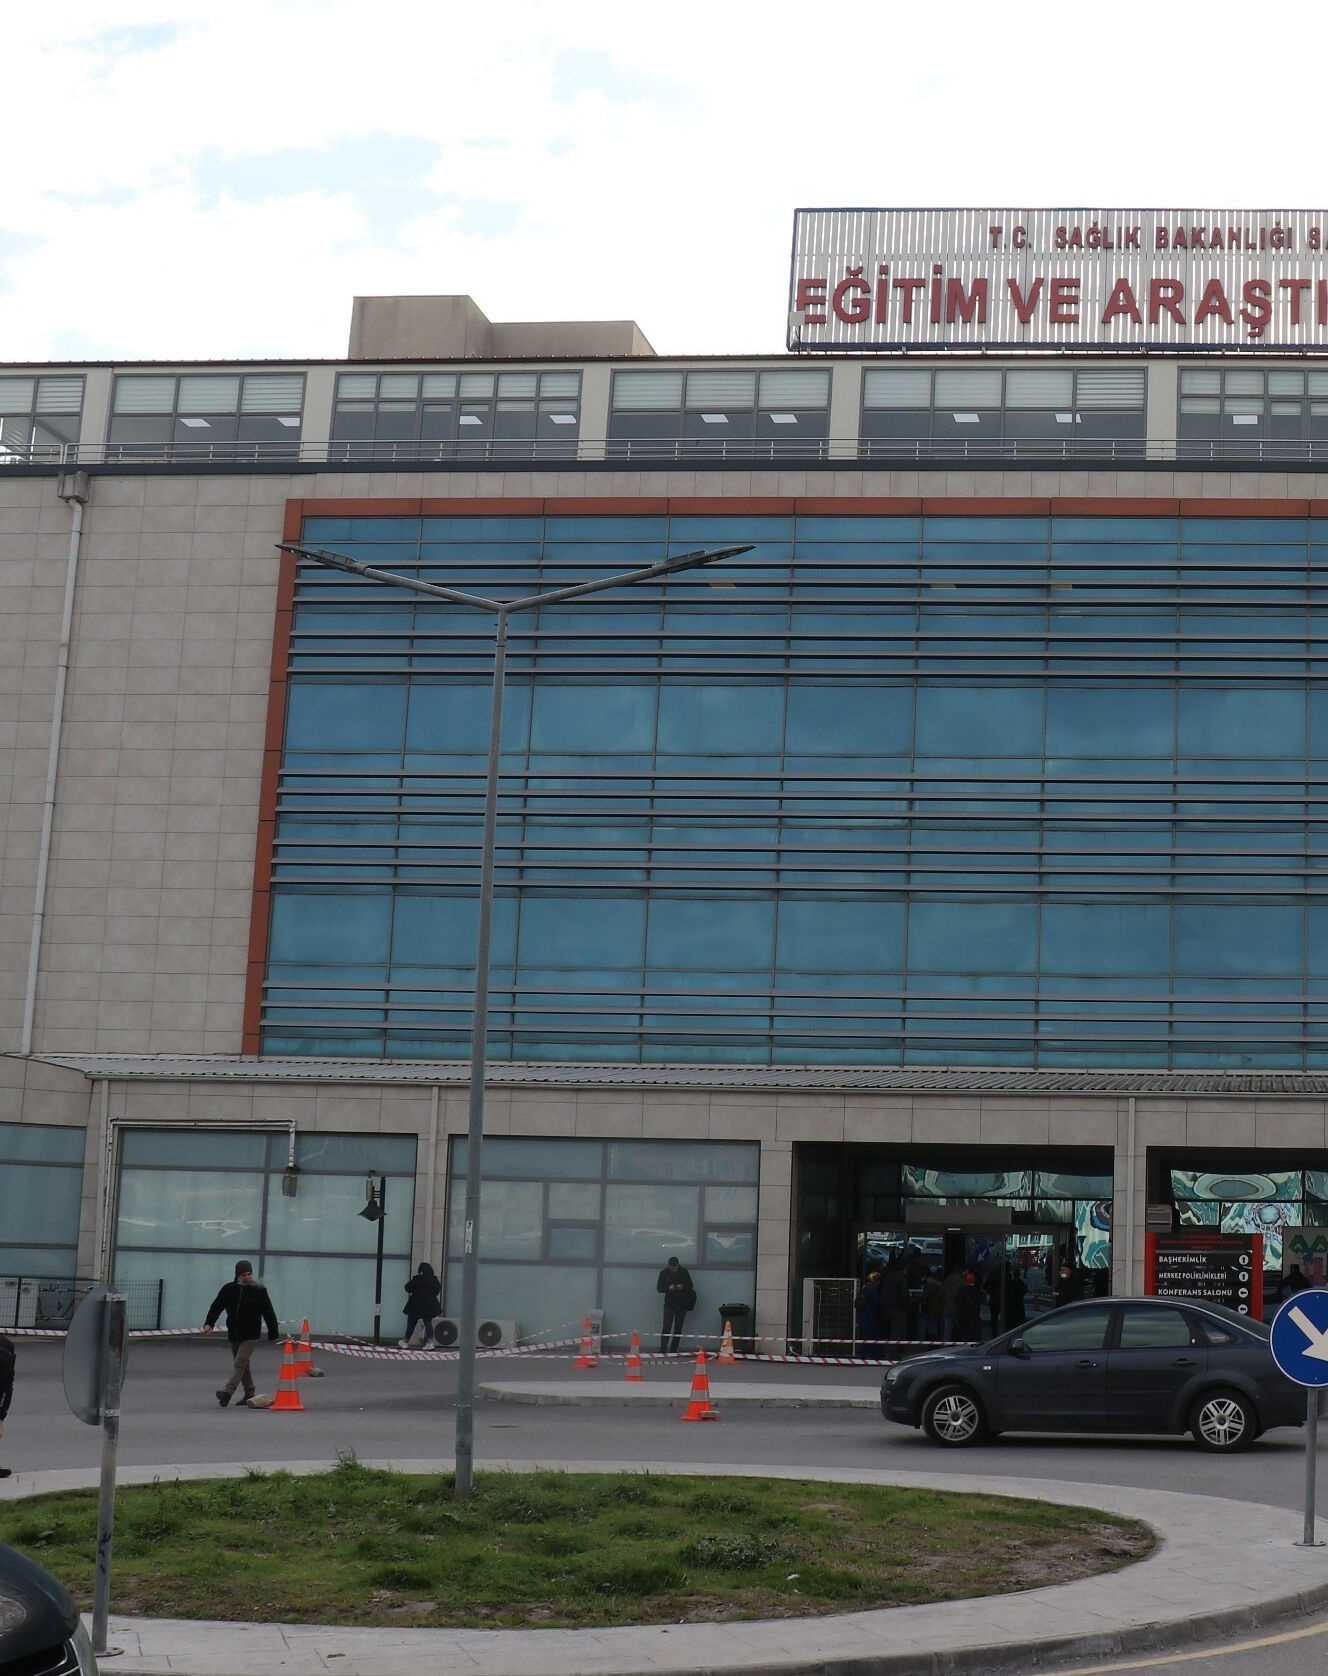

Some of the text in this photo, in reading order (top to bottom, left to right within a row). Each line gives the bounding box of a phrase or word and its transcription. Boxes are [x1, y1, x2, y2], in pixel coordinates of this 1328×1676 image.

[1055, 220, 1142, 250] SAĞLIK
[1155, 220, 1294, 251] BAKANLIĞI
[796, 264, 988, 326] EĞİTİM
[1006, 278, 1081, 325] VE
[1159, 1254, 1207, 1264] BAŞHEKİMLİK
[1159, 1271, 1227, 1280] MERKEZ POLİKLİNİKLERİ
[1159, 1288, 1233, 1296] KONFERANS SALONU
